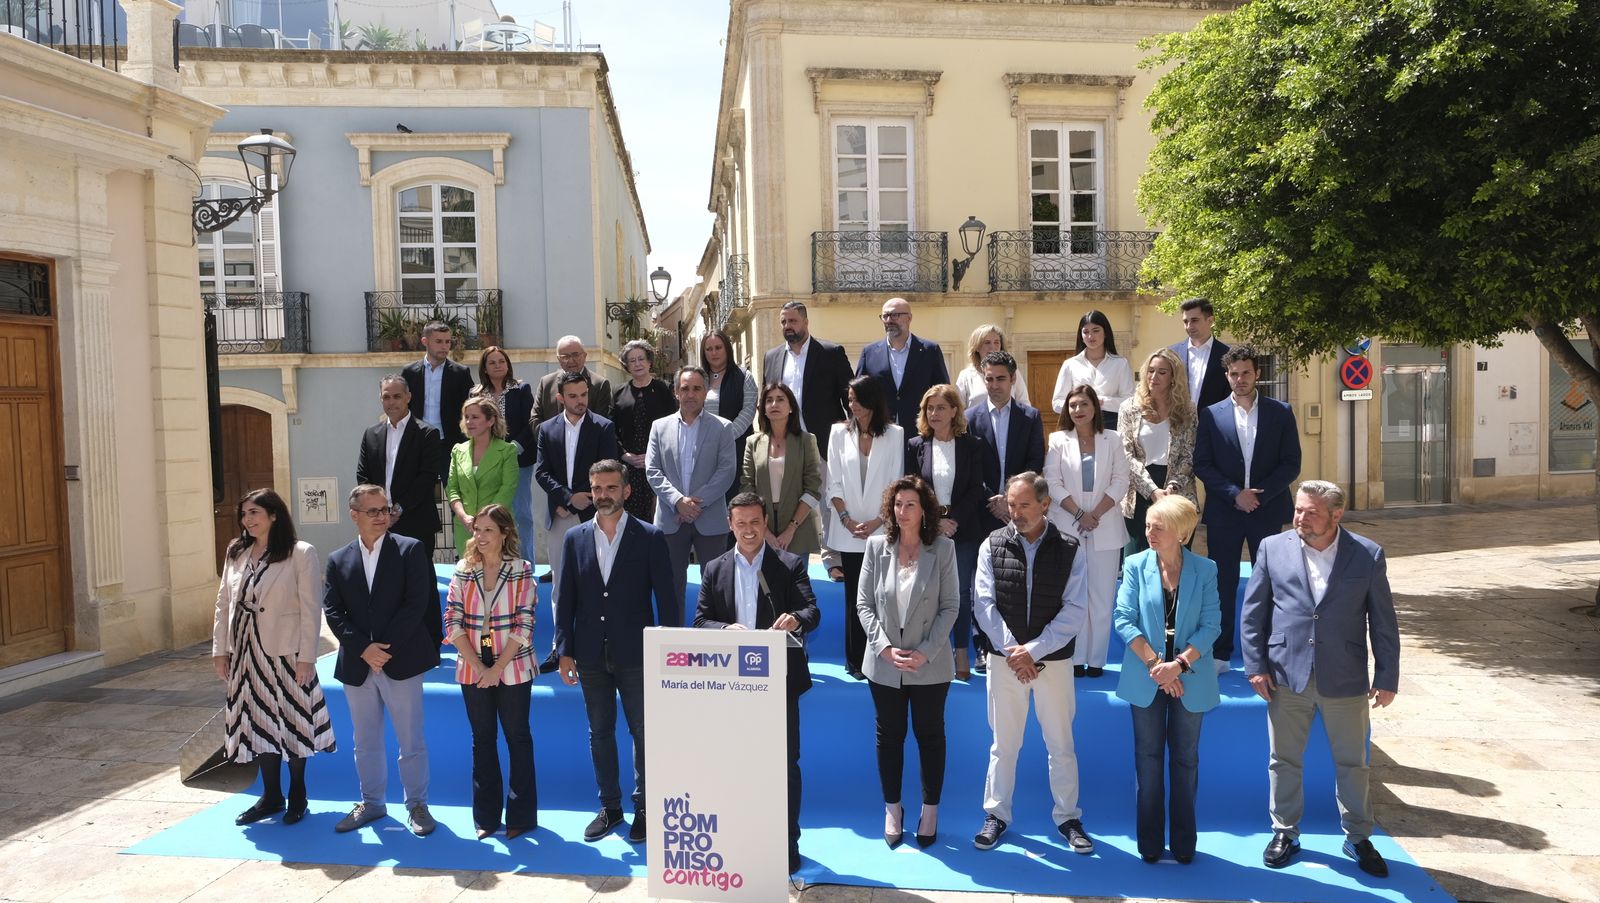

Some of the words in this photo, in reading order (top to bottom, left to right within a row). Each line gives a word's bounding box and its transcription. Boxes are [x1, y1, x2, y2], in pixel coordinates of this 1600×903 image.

[666, 652, 732, 667] 28MMV
[661, 680, 688, 690] María
[690, 680, 705, 690] del
[707, 681, 726, 690] Mar
[728, 681, 768, 692] Vázquez
[664, 792, 690, 814] mi
[663, 812, 718, 833] COM
[663, 831, 713, 852] PRO
[664, 850, 724, 871] MISO
[663, 867, 743, 892] contigo
